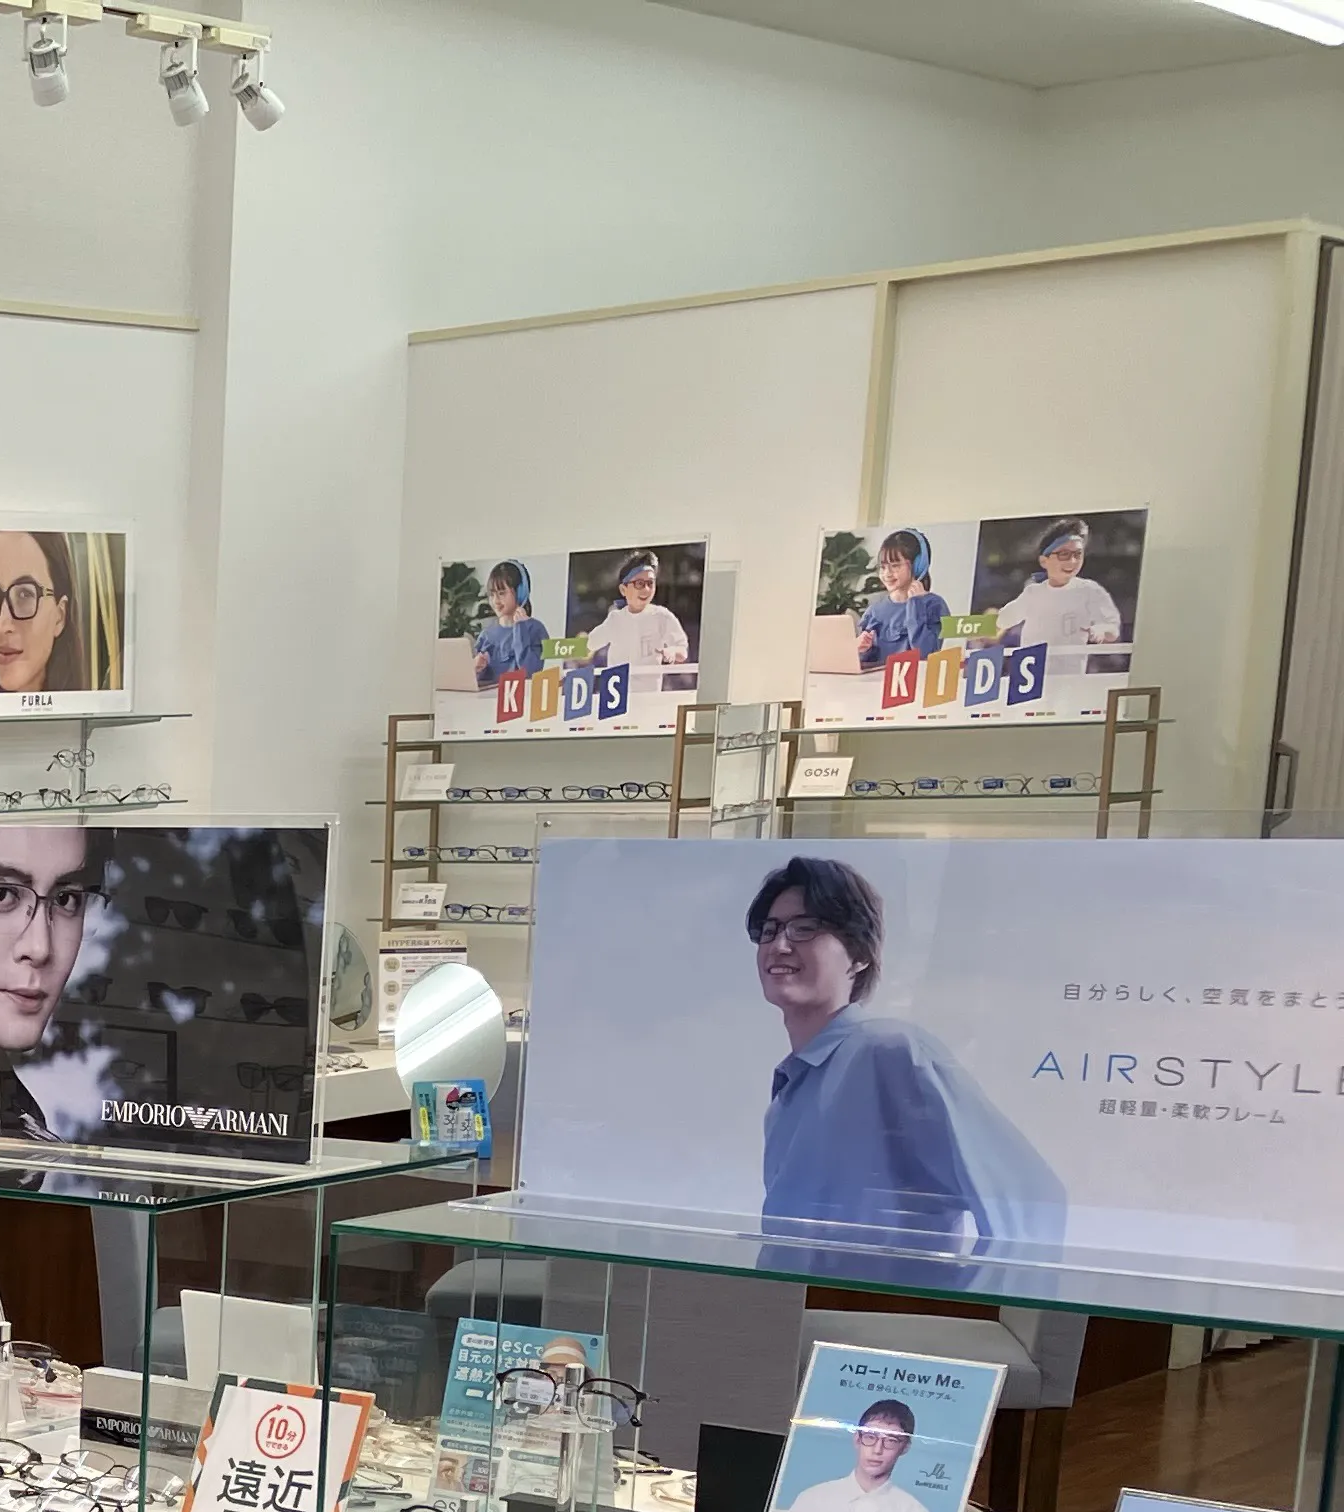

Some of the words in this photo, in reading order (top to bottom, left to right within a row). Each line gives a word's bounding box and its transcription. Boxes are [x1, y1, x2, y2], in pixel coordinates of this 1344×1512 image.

[956, 618, 982, 635] for
[553, 641, 576, 657] for
[889, 655, 1036, 699] KIDS
[21, 694, 53, 707] FURLA
[502, 675, 623, 714] KIDS
[804, 768, 839, 778] GOSH
[1031, 1051, 1344, 1096] AIRSTYL
[101, 1100, 186, 1128] EMPORIO
[211, 1109, 289, 1137] ARMANI
[893, 1368, 931, 1386] New
[267, 1416, 297, 1443] 10分
